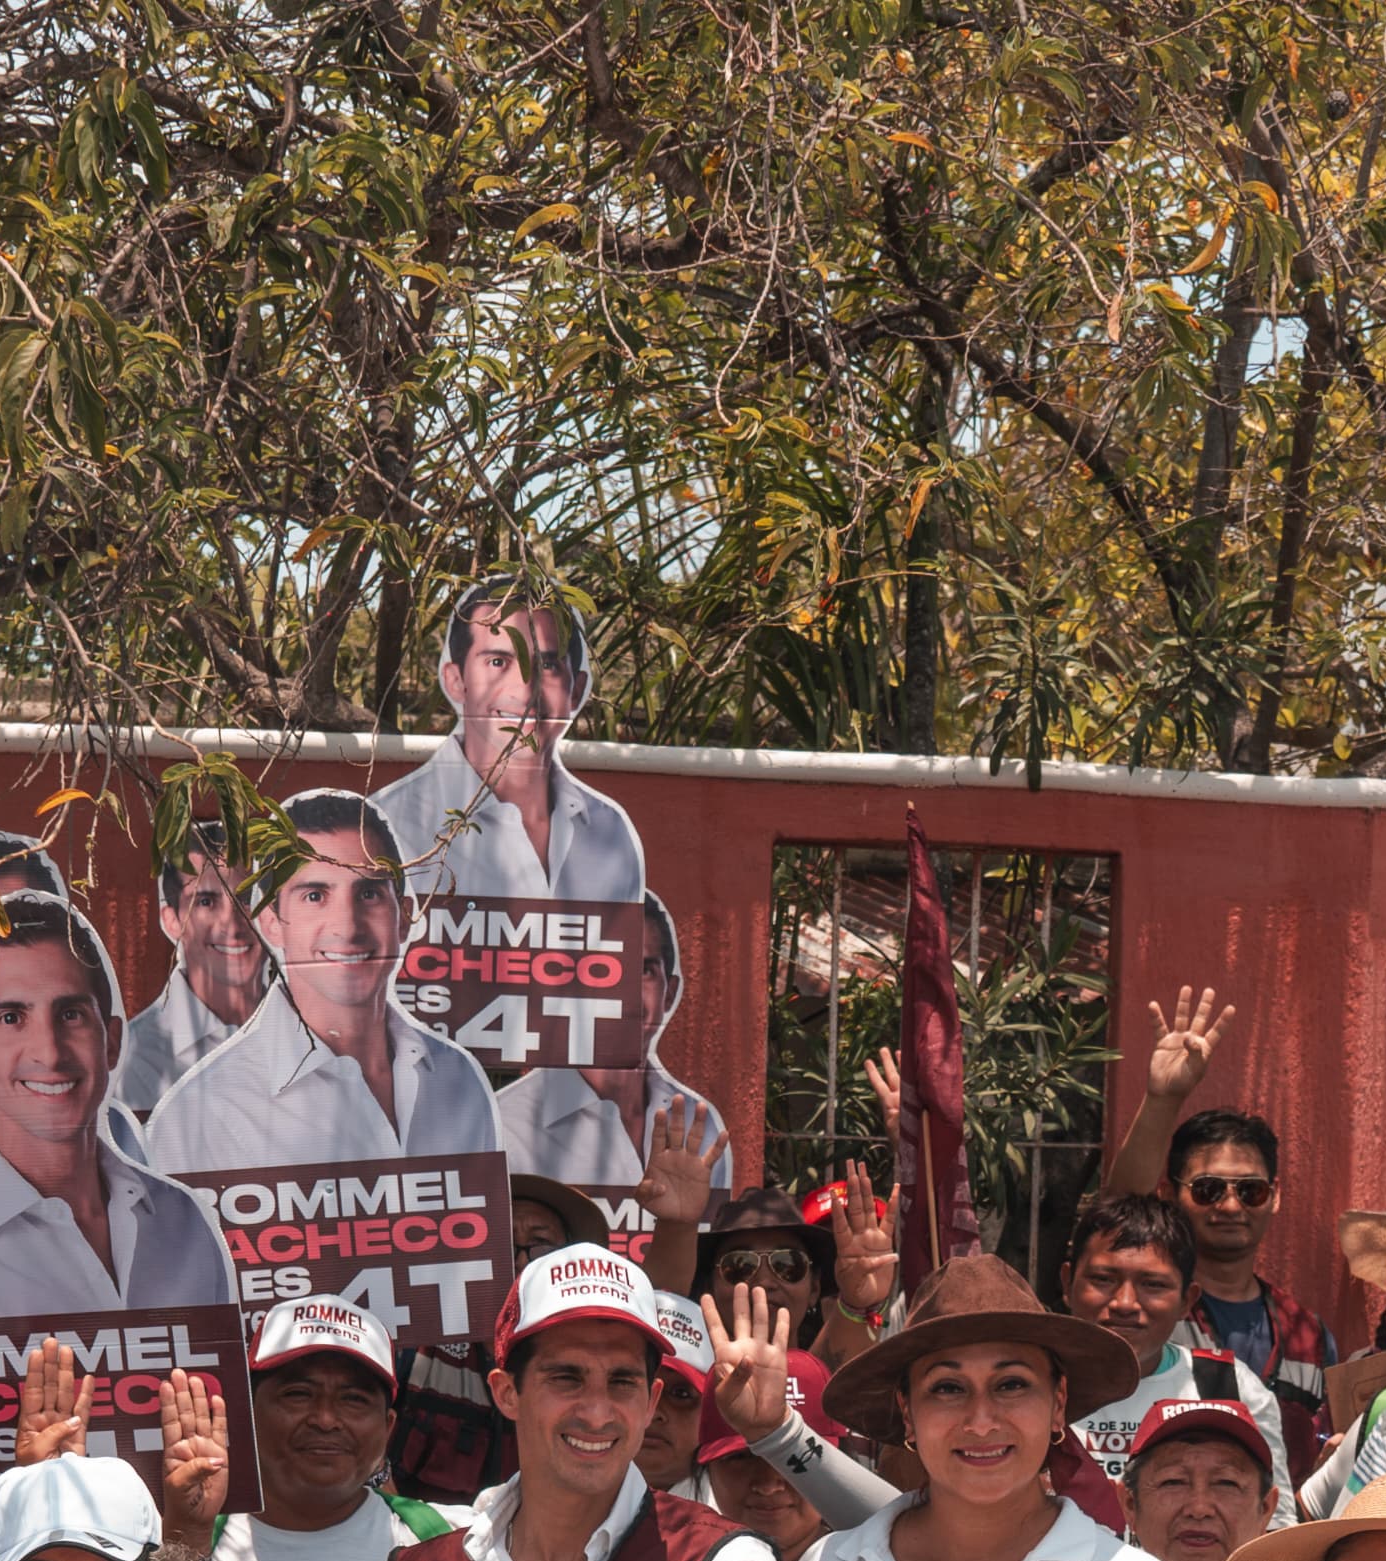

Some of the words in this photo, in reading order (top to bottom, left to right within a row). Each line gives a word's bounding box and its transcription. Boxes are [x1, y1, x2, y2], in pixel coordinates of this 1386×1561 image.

[455, 995, 623, 1065] 4T
[241, 1266, 312, 1301] ES
[550, 1258, 634, 1289] ROMMEL
[340, 1259, 493, 1339] 4T
[561, 1285, 629, 1303] morena
[293, 1305, 368, 1332] ROMMEL
[300, 1324, 360, 1343] morena
[1087, 1421, 1095, 1431] 2
[1099, 1421, 1116, 1432] DE
